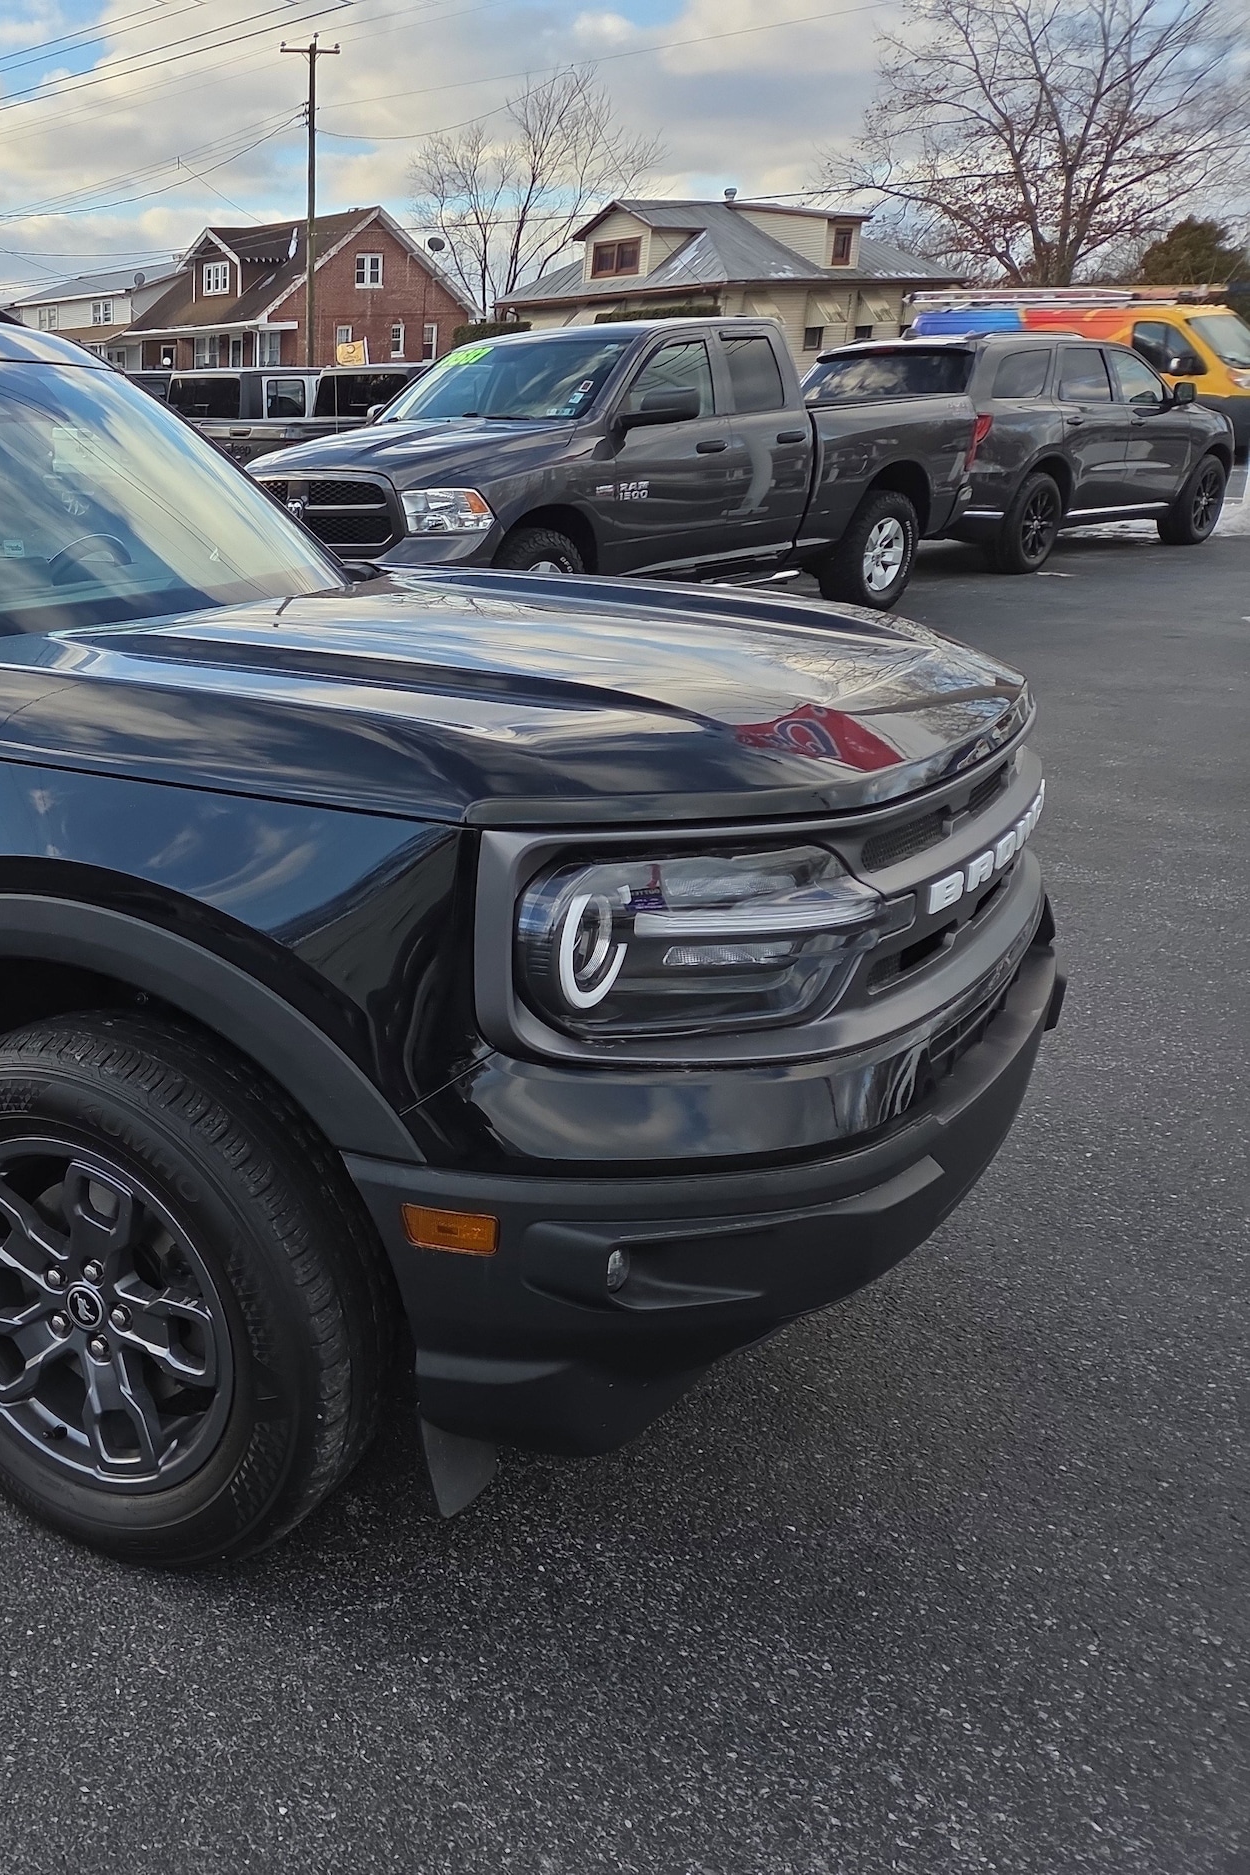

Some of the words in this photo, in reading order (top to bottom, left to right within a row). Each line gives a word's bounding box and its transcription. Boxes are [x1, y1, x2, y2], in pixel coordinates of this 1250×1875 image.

[620, 481, 649, 491] RAM
[620, 490, 648, 500] 1500
[75, 1098, 202, 1202] KUMHO
